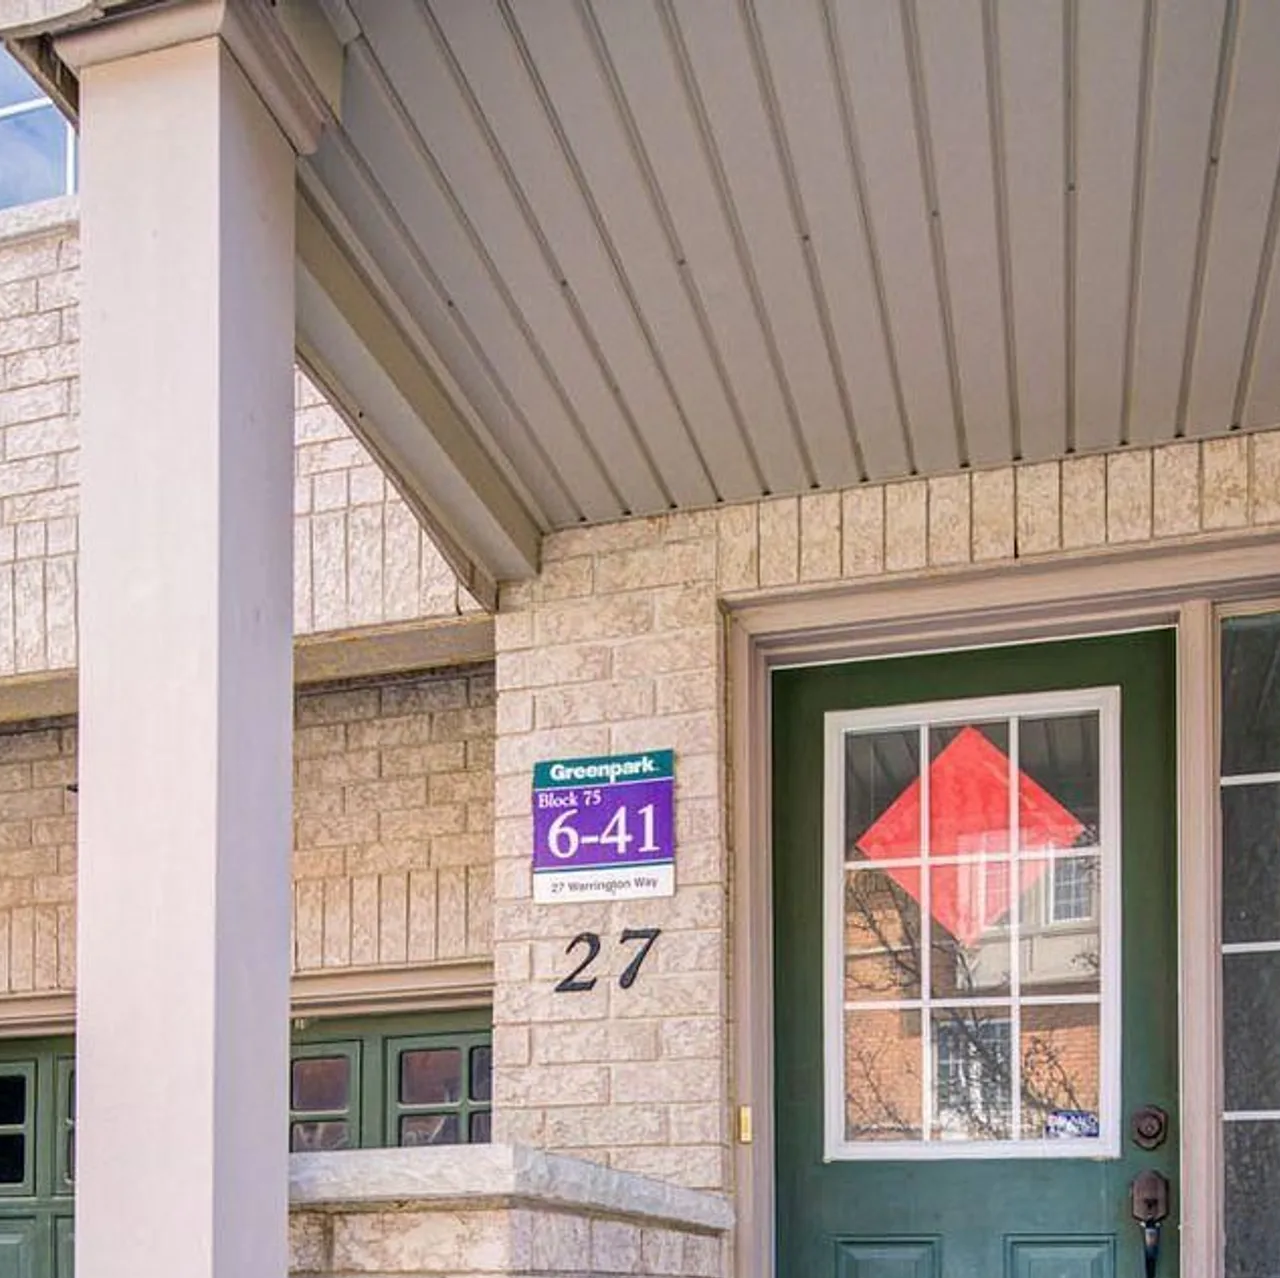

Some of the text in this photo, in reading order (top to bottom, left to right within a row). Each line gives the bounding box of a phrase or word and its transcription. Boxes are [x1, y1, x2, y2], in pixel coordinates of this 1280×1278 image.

[550, 756, 655, 784] Greenpark
[538, 789, 602, 808] Block 75
[547, 804, 661, 859] 6-41
[633, 876, 658, 890] Way
[554, 928, 662, 992] 27
